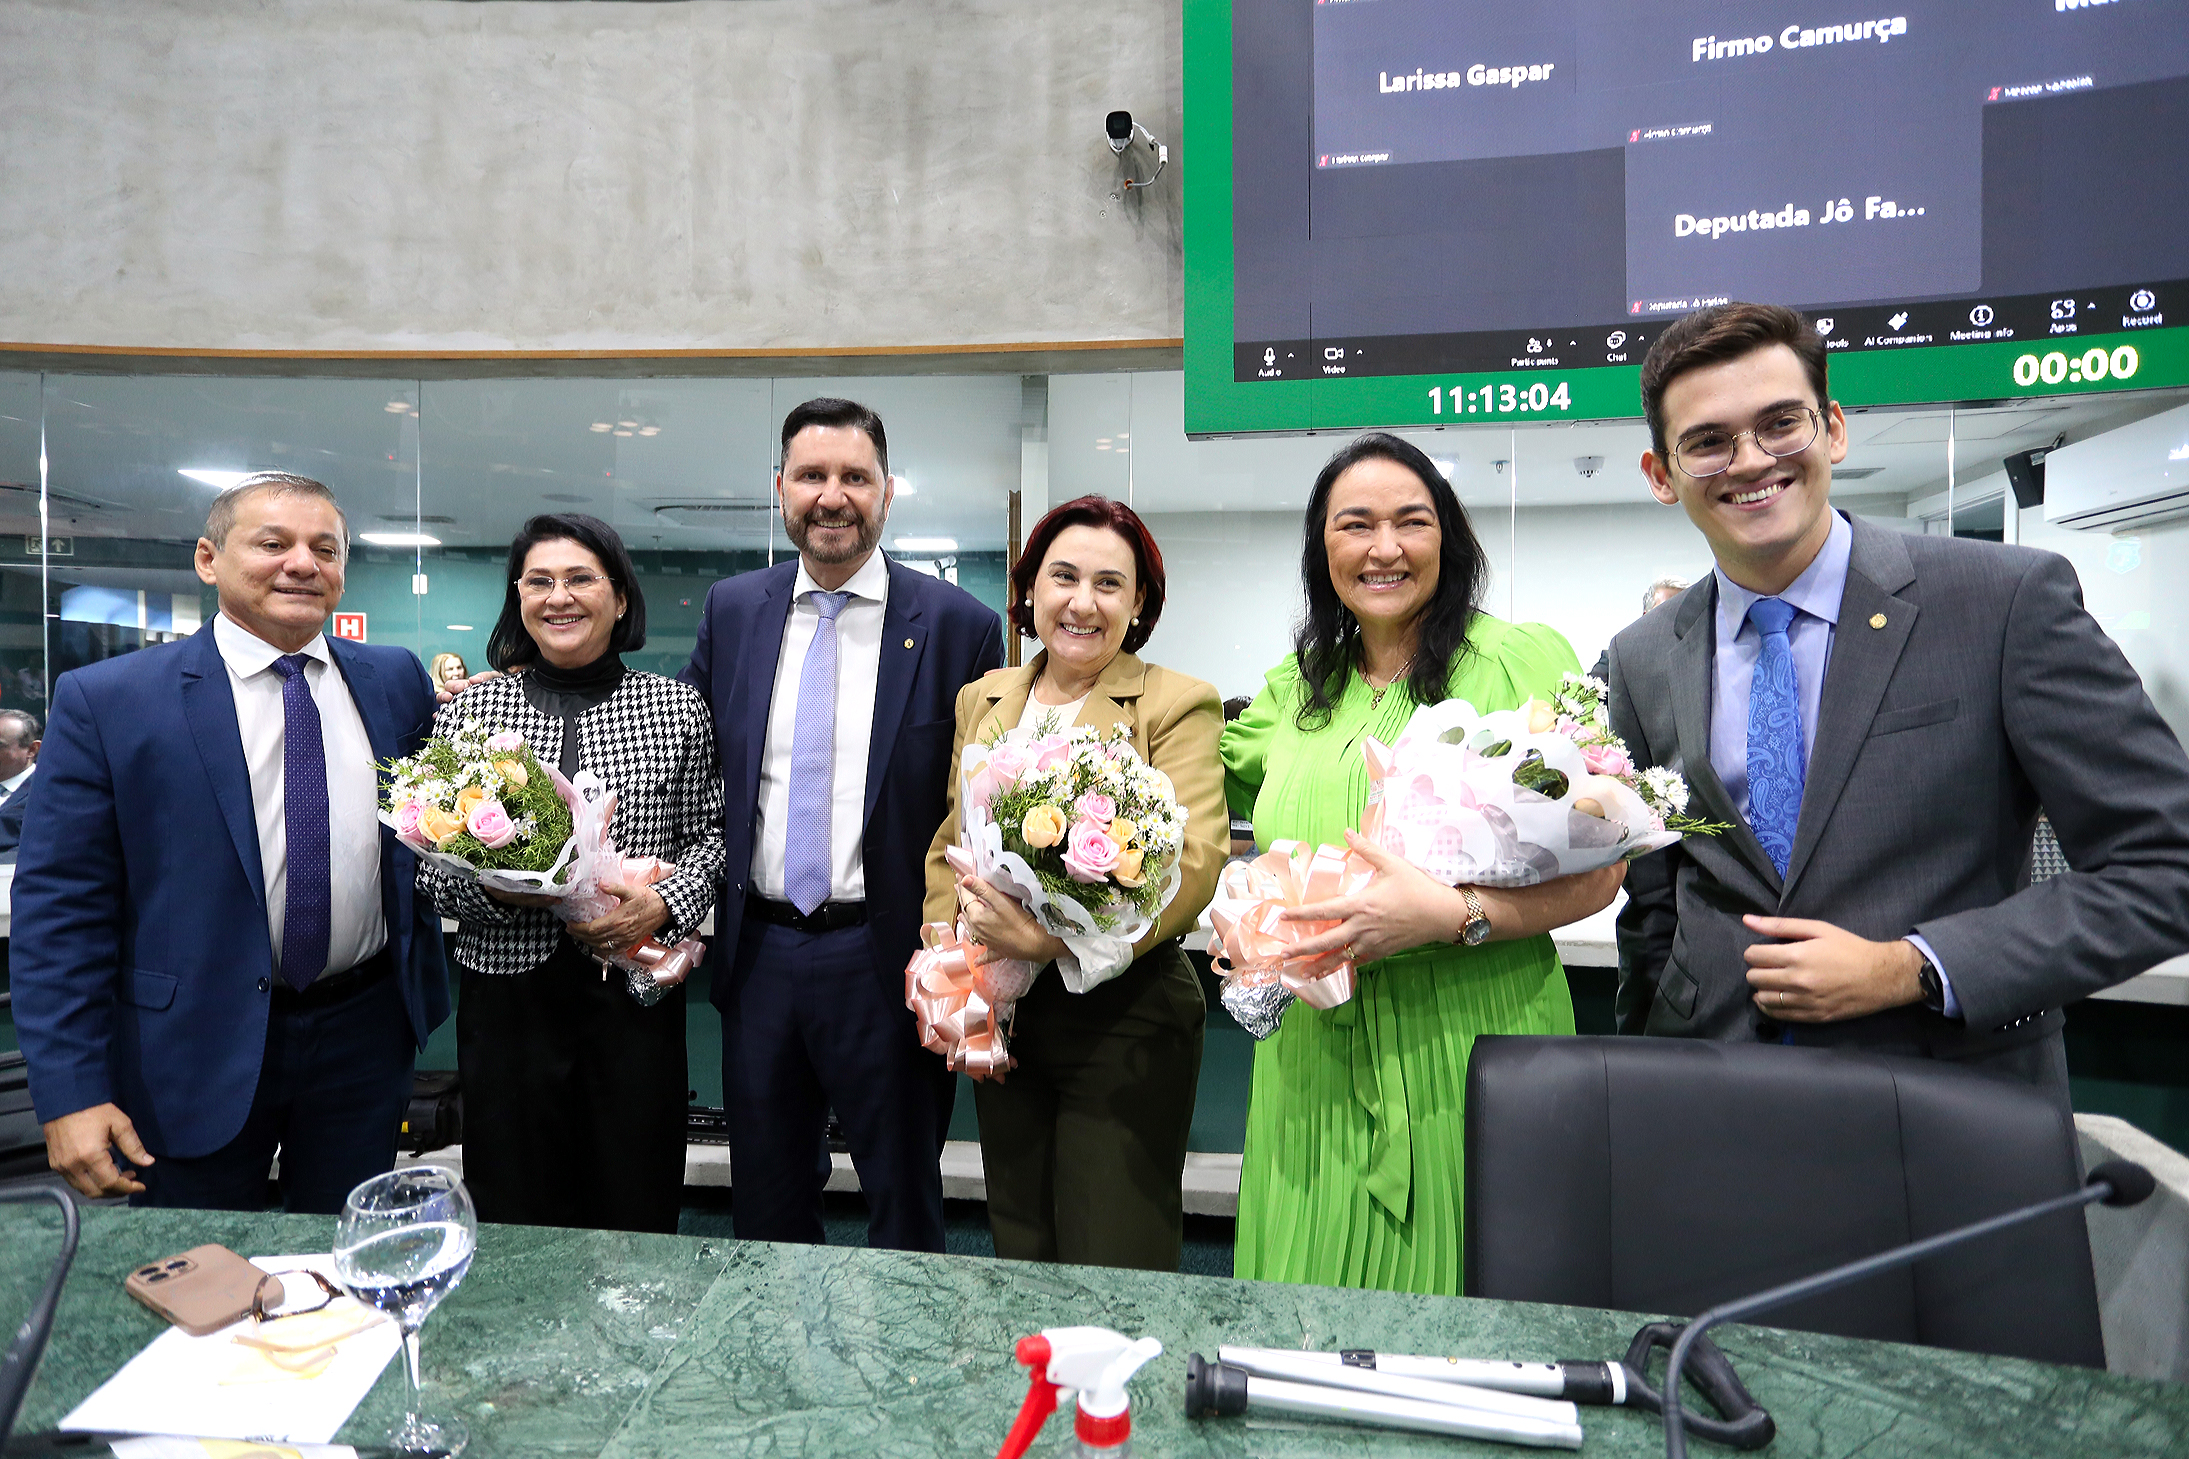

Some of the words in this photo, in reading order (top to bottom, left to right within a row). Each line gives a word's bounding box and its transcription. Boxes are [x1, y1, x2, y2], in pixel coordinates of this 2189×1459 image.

[1691, 34, 1774, 62] Firmo
[1779, 15, 1907, 51] Camurça
[1379, 67, 1461, 94] Larissa
[1466, 61, 1555, 89] Gaspar
[1674, 203, 1811, 240] Deputada
[1819, 197, 1855, 225] Jô
[1993, 327, 2014, 338] nfo
[1257, 368, 1282, 378] Audo
[1511, 357, 1559, 368] Particpants
[2013, 345, 2138, 387] 00:00
[1428, 383, 1572, 415] 11:13:04
[340, 618, 359, 637] H
